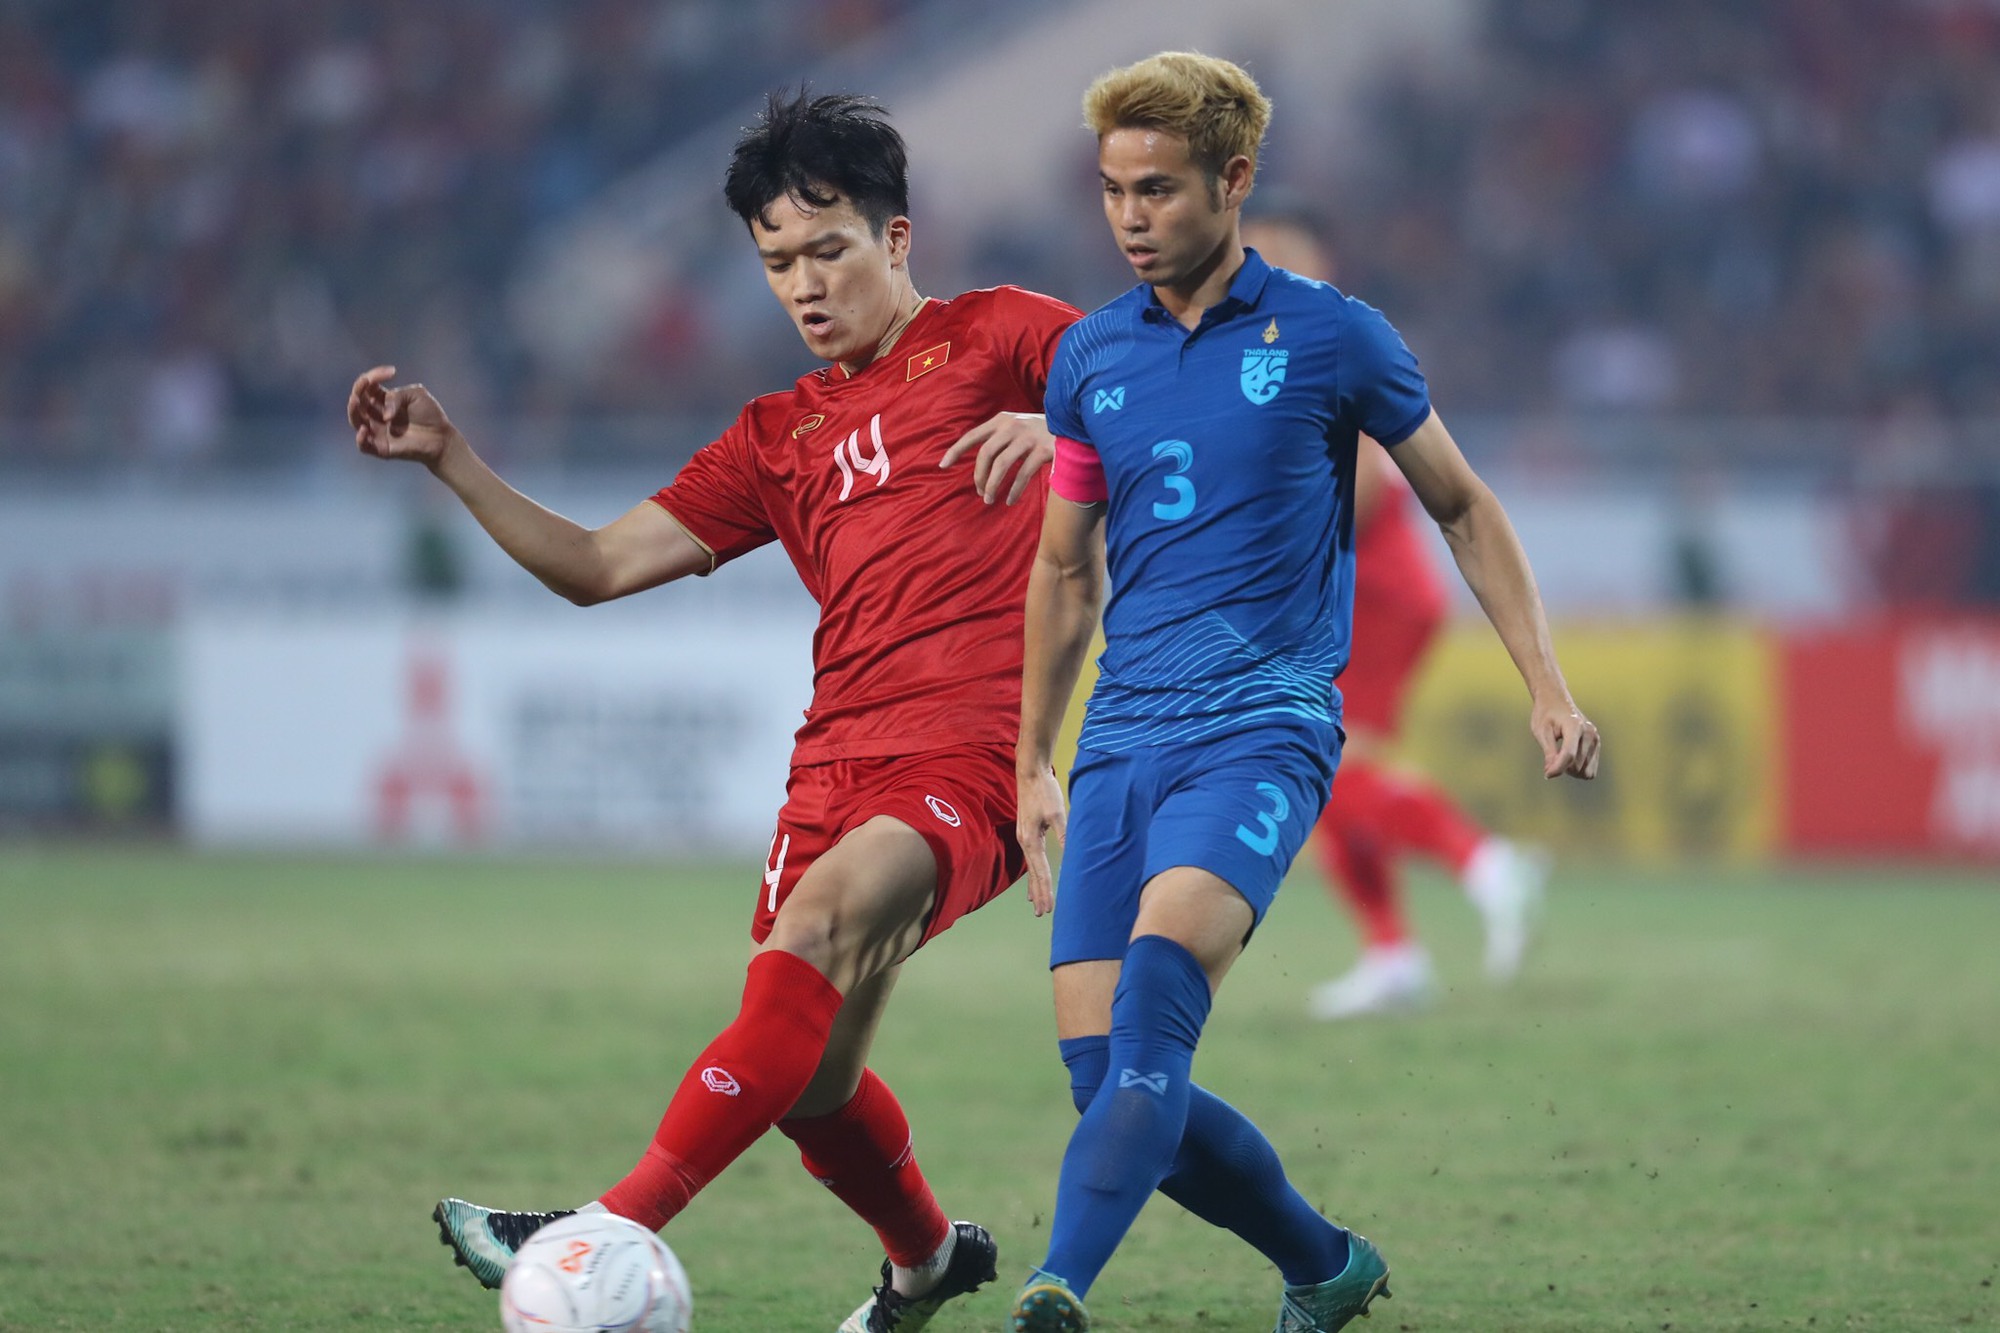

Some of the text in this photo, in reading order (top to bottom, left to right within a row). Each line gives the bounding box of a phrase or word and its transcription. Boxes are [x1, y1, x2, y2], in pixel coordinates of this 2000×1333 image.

[1243, 348, 1289, 357] THAILAND
[833, 413, 890, 501] 14
[1152, 440, 1196, 520] 3
[1236, 781, 1289, 856] 3
